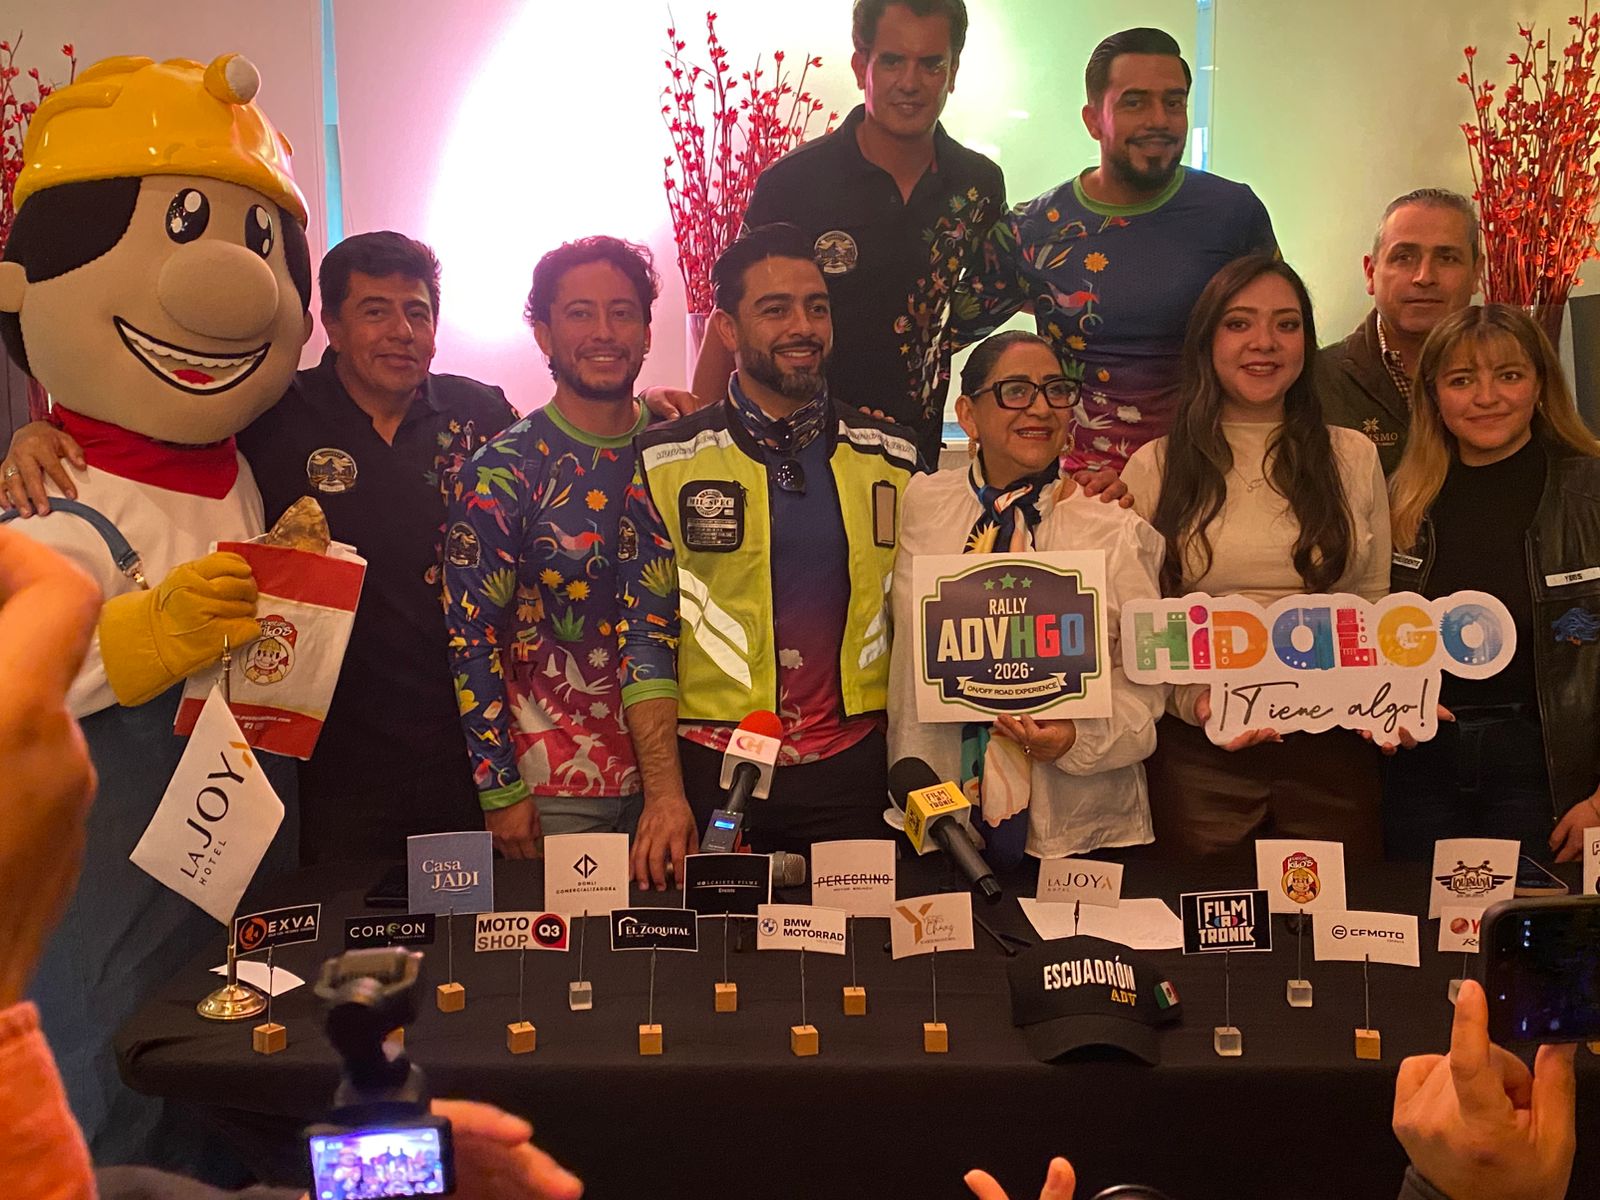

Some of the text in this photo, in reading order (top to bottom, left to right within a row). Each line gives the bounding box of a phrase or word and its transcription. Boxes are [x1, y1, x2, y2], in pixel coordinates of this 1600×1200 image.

[989, 597, 1028, 615] RALLY
[937, 613, 1085, 662] ADVHGO
[995, 662, 1029, 680] 2026
[967, 685, 993, 694] ON/OFF
[1015, 682, 1058, 695] EXPERIENCE
[1220, 678, 1428, 734] ¡Tiene algo!
[180, 852, 204, 878] LA
[199, 839, 226, 886] HOTEL
[421, 860, 461, 873] Casa
[431, 871, 480, 889] JADI
[817, 874, 890, 888] PEREGRINO
[1062, 872, 1112, 890] JOYA
[1203, 899, 1247, 928] FILM
[269, 915, 315, 933] EXVA
[478, 917, 529, 933] MOTO
[538, 924, 560, 937] Q3
[783, 919, 811, 927] BMW
[477, 934, 529, 950] SHOP
[783, 929, 844, 941] MOTORRAD
[1198, 926, 1255, 944] TRONIK
[1350, 929, 1404, 939] CFMOTO
[1043, 955, 1137, 991] ESCUADRÓN
[1111, 988, 1137, 1006] ADV
